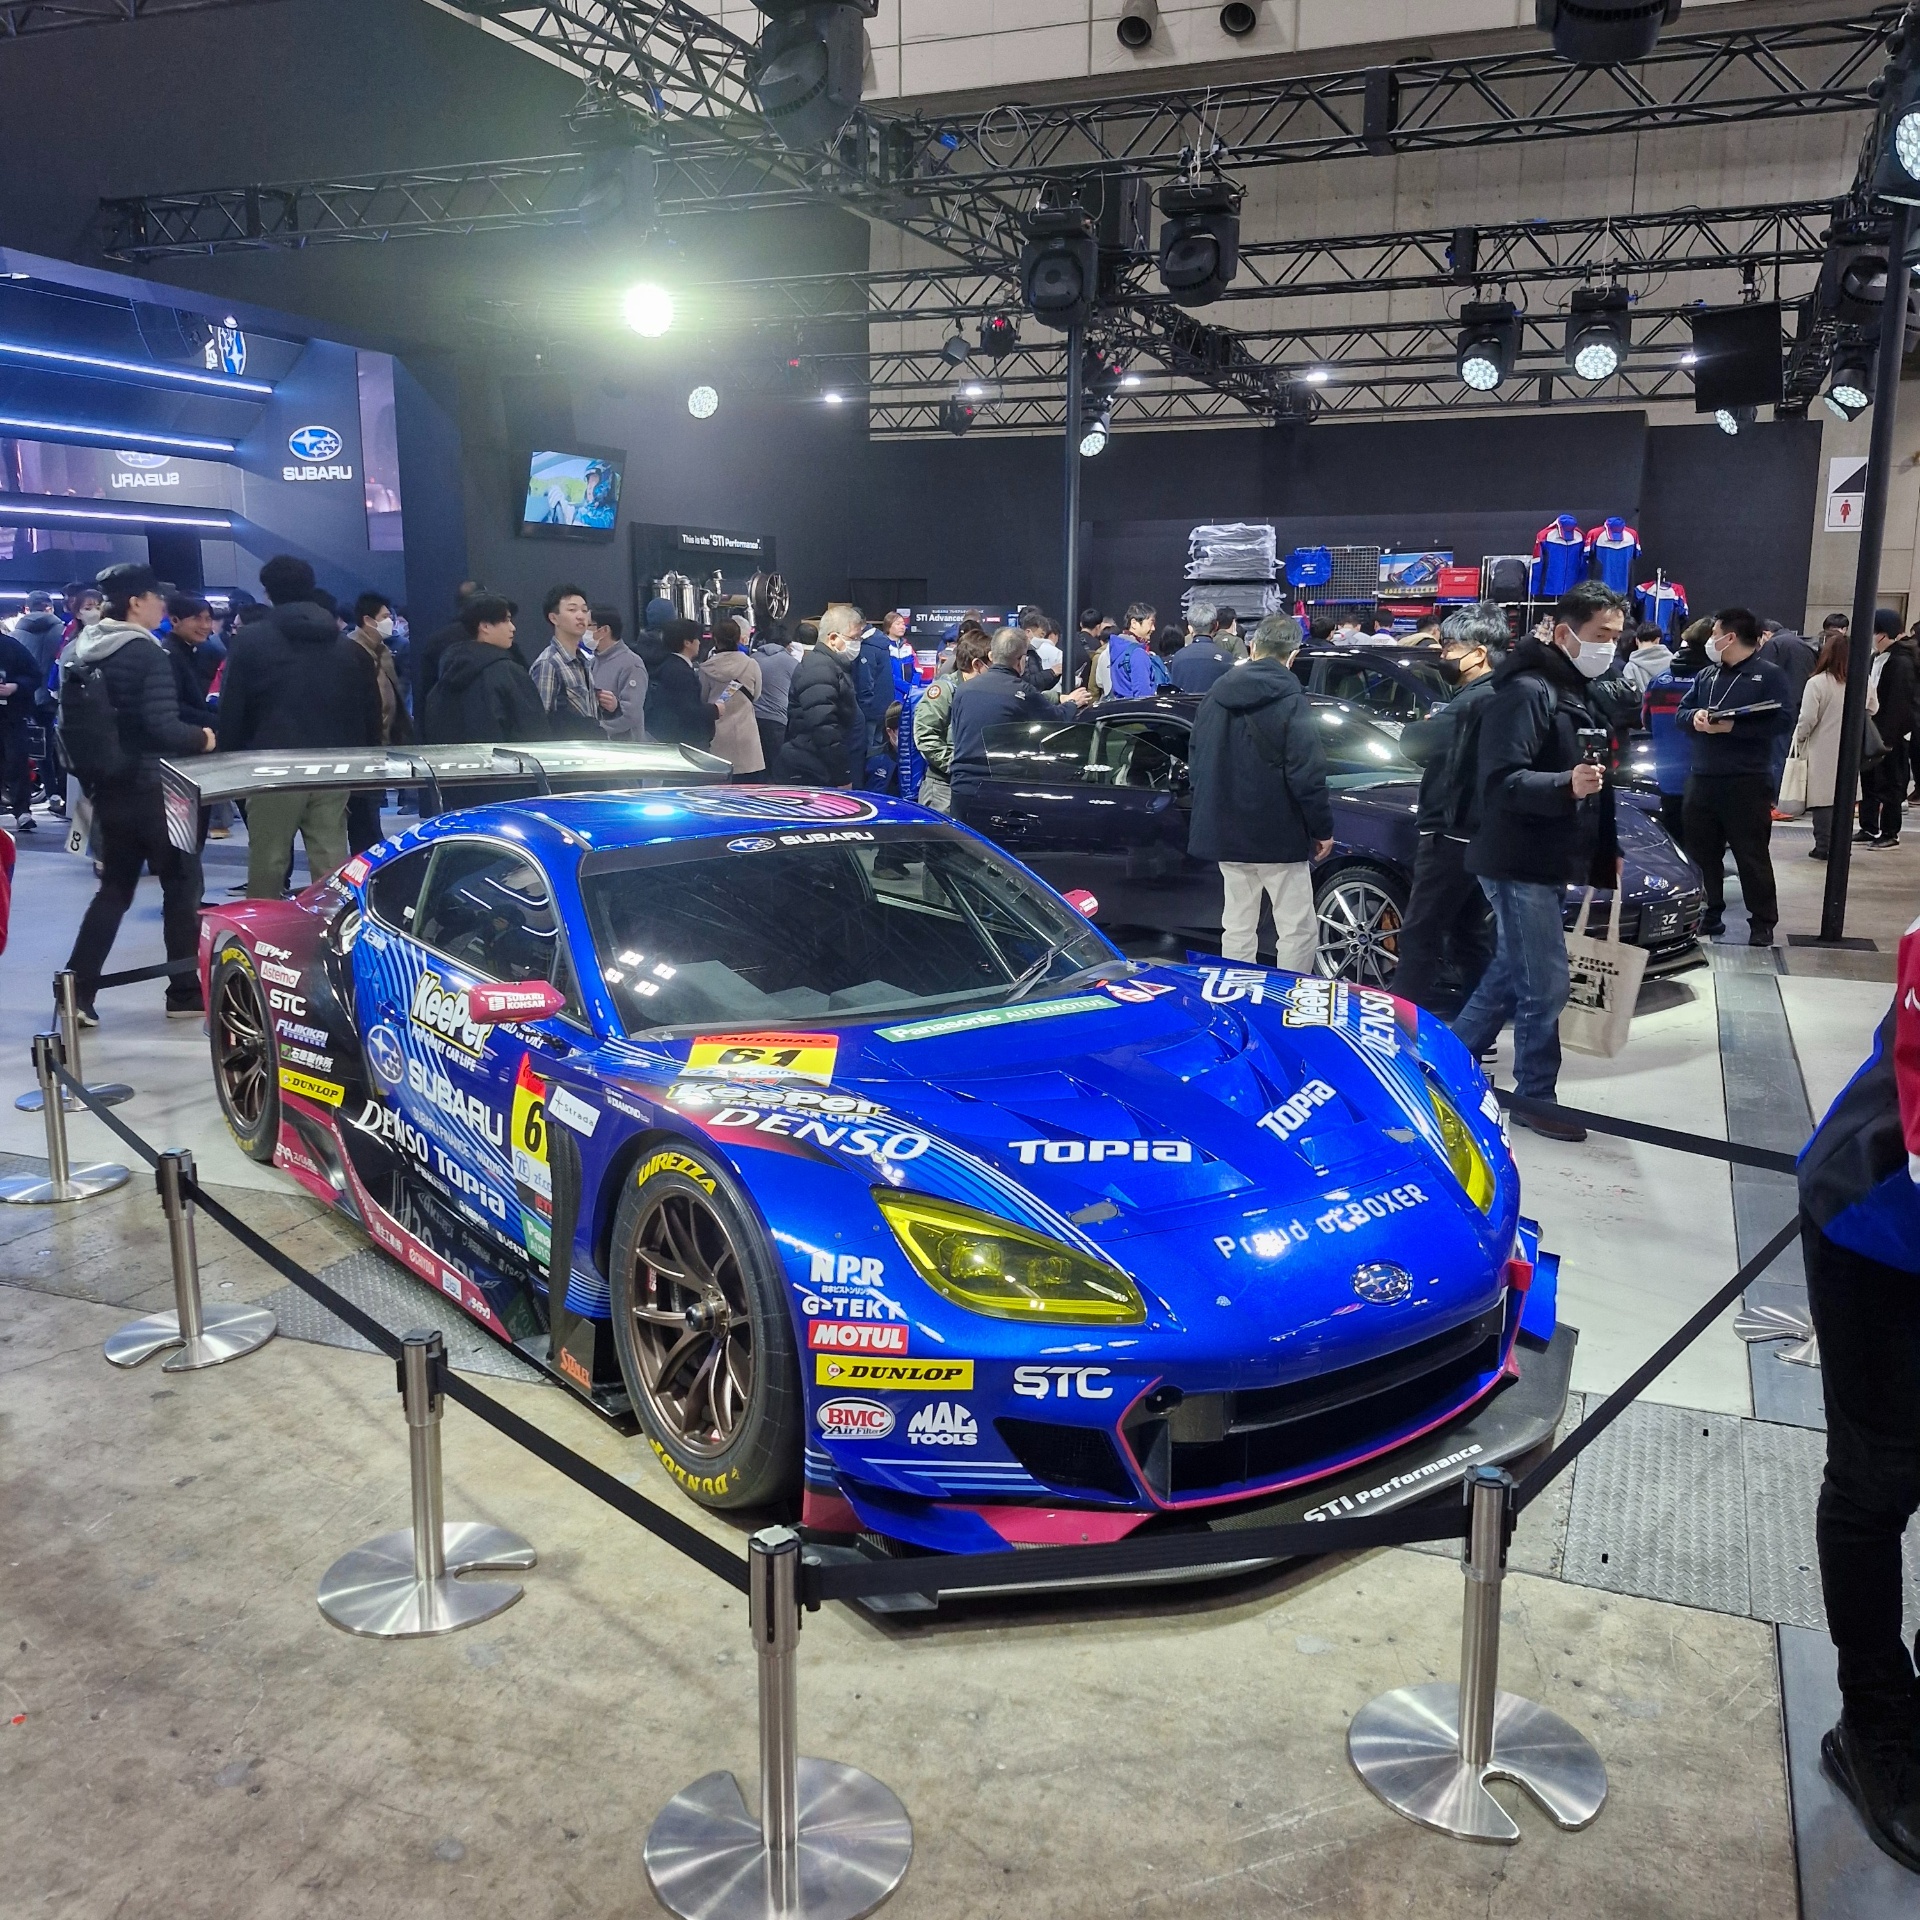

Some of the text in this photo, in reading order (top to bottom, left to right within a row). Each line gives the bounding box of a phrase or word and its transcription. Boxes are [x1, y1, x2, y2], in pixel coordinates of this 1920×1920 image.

[282, 465, 353, 481] SUBARU
[682, 534, 694, 544] This
[700, 536, 710, 546] the
[916, 613, 928, 622] STI
[250, 762, 350, 778] STI
[779, 831, 875, 846] SUBARU
[262, 966, 297, 985] Astemo
[269, 988, 307, 1017] STC
[506, 993, 545, 1001] SUBARU
[506, 1000, 546, 1010] KOHSAN
[889, 996, 1109, 1040] Panasonic AUTOMOTIVE
[1359, 990, 1401, 1059] DENSO
[717, 1047, 803, 1068] 61
[291, 1077, 340, 1099] DUNLOP
[407, 1057, 504, 1147] SUBARU
[564, 1103, 595, 1127] Strada
[784, 1107, 822, 1121] CAR
[824, 1112, 869, 1125] LIFE
[353, 1099, 429, 1163] DENSO
[524, 1100, 547, 1157] 6
[706, 1107, 931, 1161] DENSO
[637, 1150, 718, 1196] DIREZZA
[1213, 1218, 1310, 1259] Prud
[1345, 1183, 1430, 1226] BOXER
[810, 1254, 885, 1288] NPR
[802, 1295, 902, 1321] G-TEKT
[813, 1323, 904, 1350] MOTUL
[848, 1364, 964, 1382] DUNLOP
[1012, 1365, 1116, 1401] STC
[827, 1407, 885, 1429] BMC
[907, 1401, 979, 1434] MAC
[827, 1425, 881, 1436] Air Filter
[907, 1432, 979, 1446] TOOLS
[649, 1438, 729, 1497] DUNLOP
[1303, 1443, 1484, 1522] STI Performance
